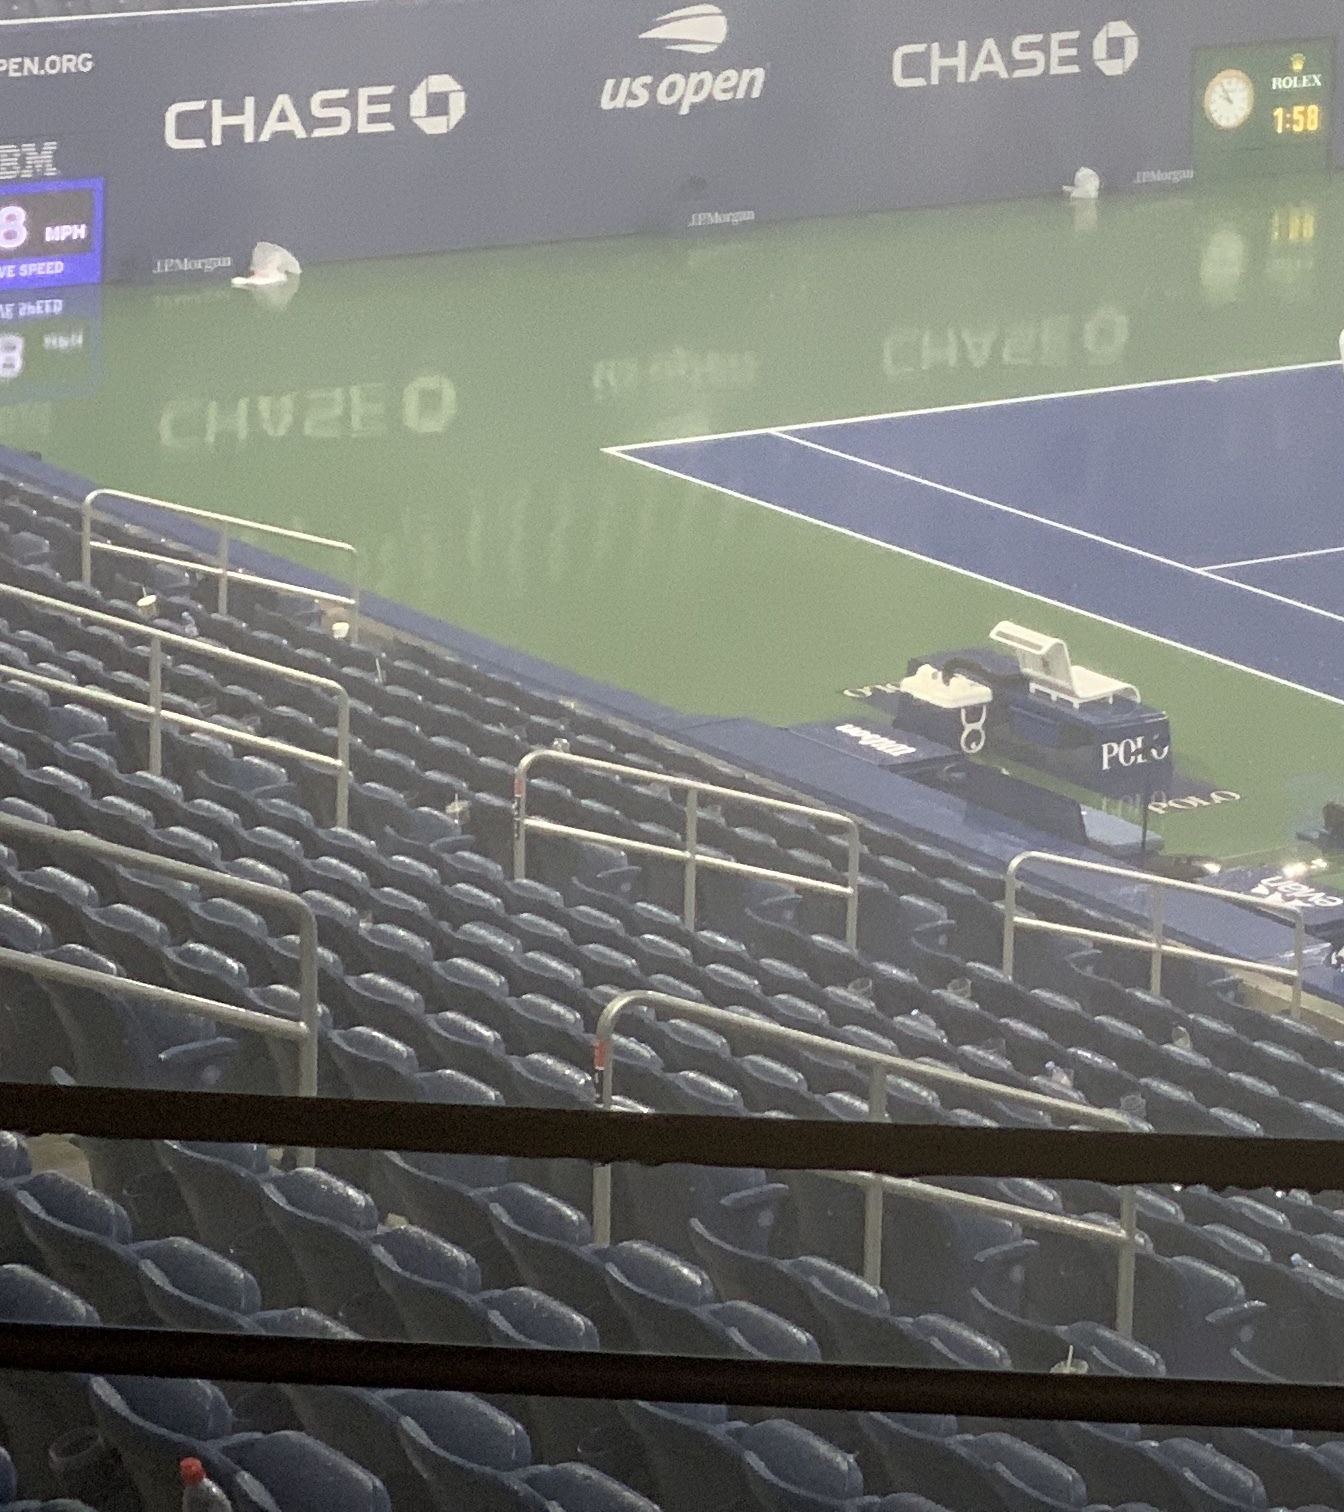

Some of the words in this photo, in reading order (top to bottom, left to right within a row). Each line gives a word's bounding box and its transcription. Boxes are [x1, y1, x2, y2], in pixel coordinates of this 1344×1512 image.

[892, 31, 1080, 88] CHASE
[600, 75, 653, 110] us
[656, 67, 766, 115] open
[1271, 74, 1322, 90] ROLEX
[165, 85, 396, 149] CHASE
[1272, 104, 1320, 134] 1:58
[45, 224, 87, 242] MPH
[18, 261, 65, 276] SPEED
[1148, 790, 1241, 814] POLO
